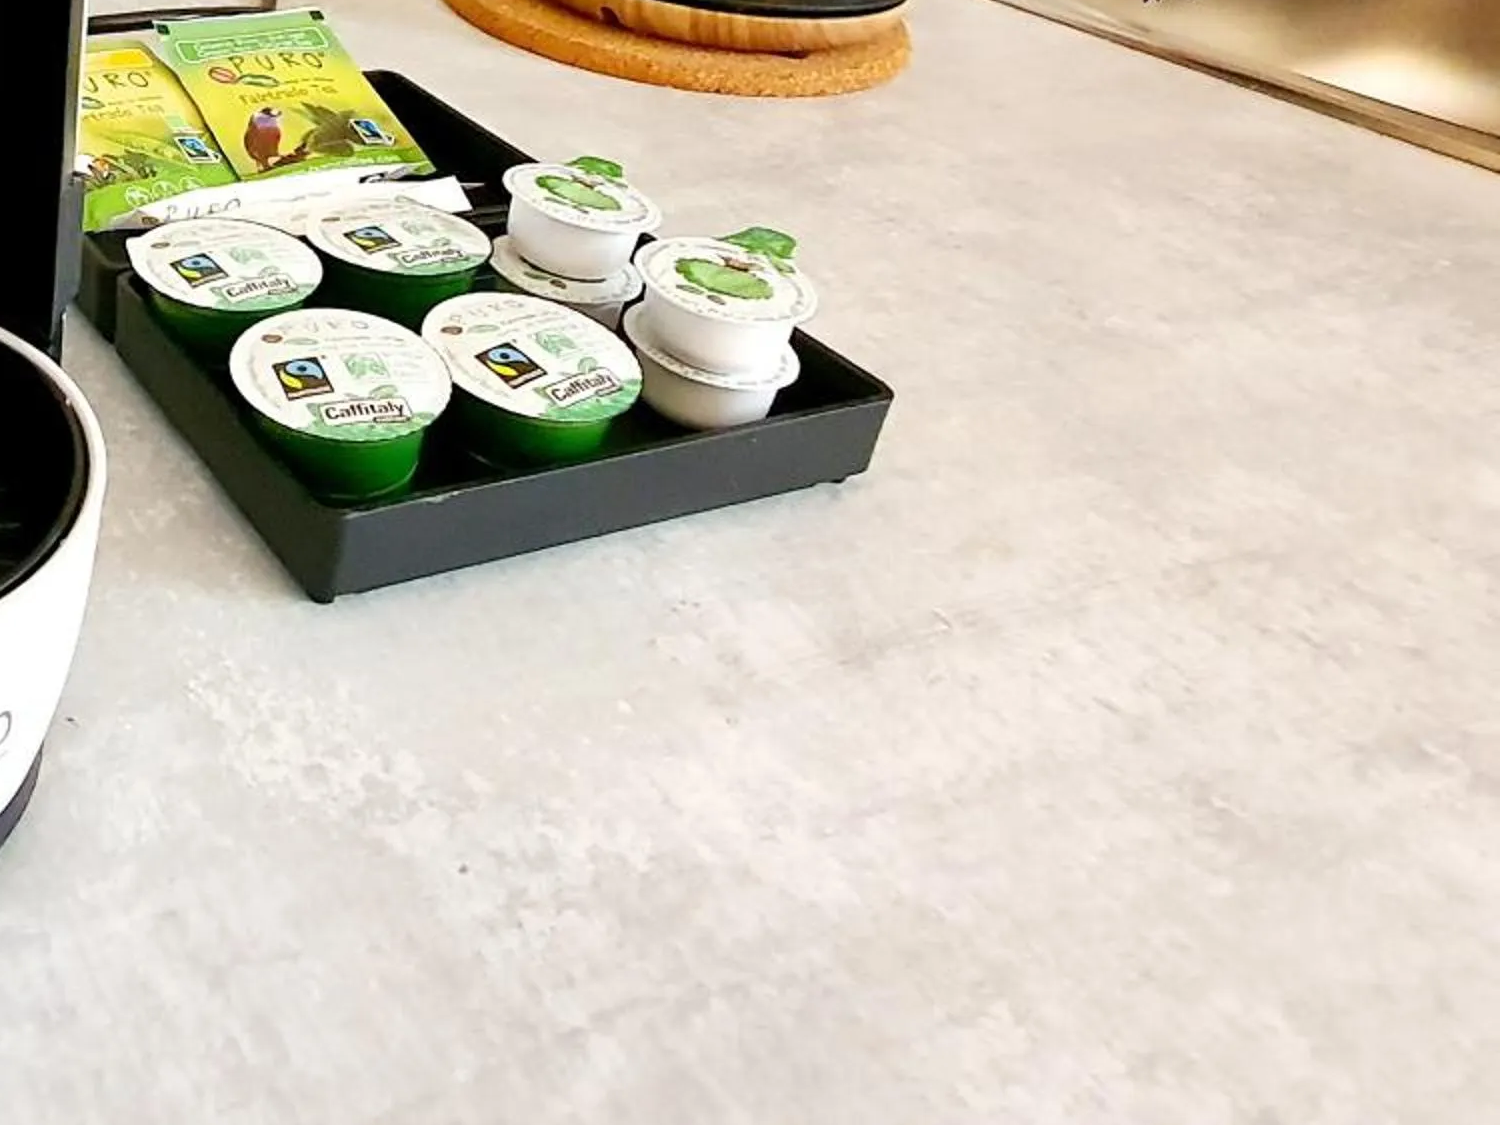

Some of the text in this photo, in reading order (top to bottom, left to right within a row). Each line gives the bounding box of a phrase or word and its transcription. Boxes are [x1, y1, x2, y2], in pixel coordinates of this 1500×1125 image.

[228, 52, 324, 74] PURO
[83, 71, 150, 93] URO
[226, 277, 292, 298] Caffitaly
[551, 373, 614, 402] Caffitaly
[324, 400, 406, 420] Caffitaly
